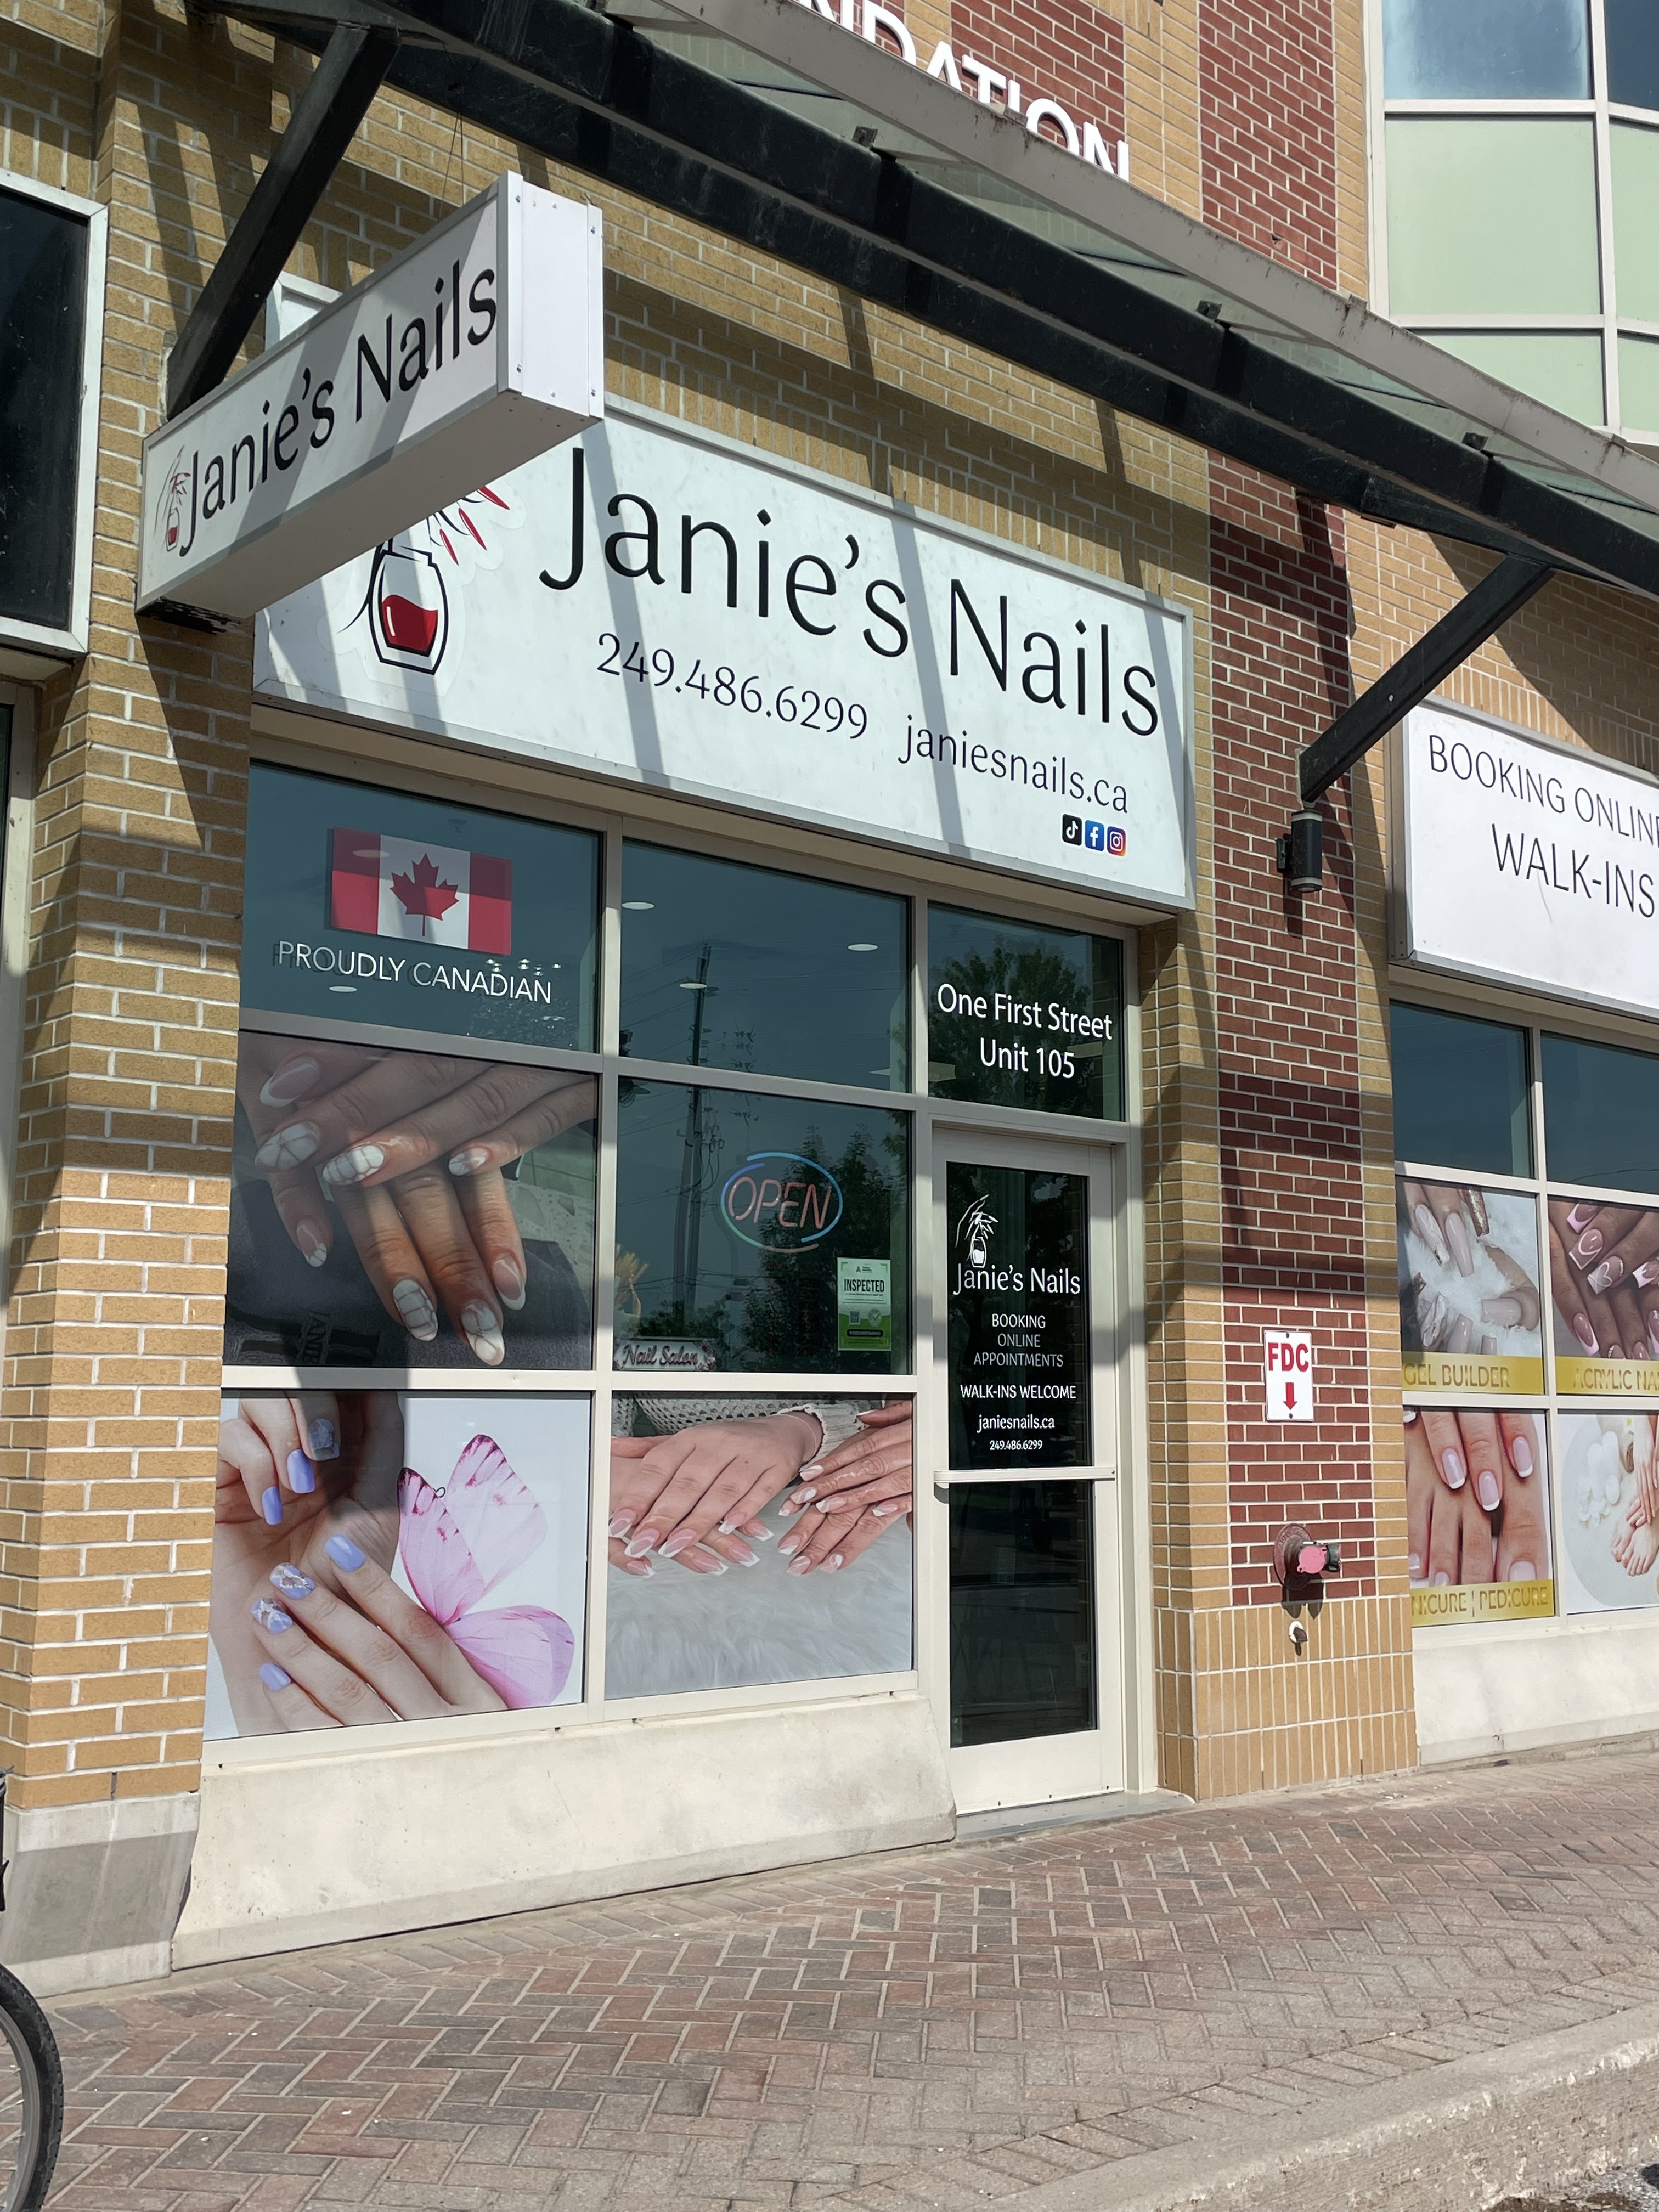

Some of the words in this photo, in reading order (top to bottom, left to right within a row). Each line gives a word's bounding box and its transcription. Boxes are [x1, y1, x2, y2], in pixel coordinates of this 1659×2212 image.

[180, 368, 335, 557] Janie's
[356, 259, 496, 423] Nails
[539, 448, 909, 657] Janie's
[950, 579, 1158, 736] Nails
[597, 633, 867, 739] 249.486.6299
[898, 714, 1128, 814] janiesnails.ca
[1429, 735, 1565, 813] BOOKING
[1492, 823, 1655, 918] WALK-INS
[279, 940, 405, 981] PROUDLY
[413, 962, 551, 1004] CANADIAN
[938, 984, 987, 1018] One
[995, 992, 1042, 1028] First
[1048, 1003, 1113, 1040] Street
[980, 1037, 1029, 1072] Unit
[1036, 1048, 1075, 1079] 105
[728, 1176, 832, 1229] OPEN
[844, 1279, 885, 1292] INSPECTED
[952, 1263, 1024, 1295] Janie's
[1030, 1267, 1081, 1295] Nails
[992, 1313, 1046, 1329] BOOKING
[997, 1333, 1041, 1348] ONLINE
[623, 1344, 657, 1365] Nail
[659, 1345, 698, 1365] Salon
[973, 1352, 1064, 1367] APPOINTMENTS
[1268, 1342, 1309, 1372] FDC
[1403, 1363, 1437, 1386] GEL
[1442, 1364, 1510, 1387] BUILDER
[1573, 1368, 1633, 1390] ACRYLIC
[961, 1384, 1017, 1399] WALK-INS
[1019, 1385, 1076, 1399] WELCOME
[977, 1414, 1055, 1434] janiesnails.ca
[989, 1440, 1043, 1451] 249.486.6299
[1480, 1586, 1548, 1610] PEDICURE
